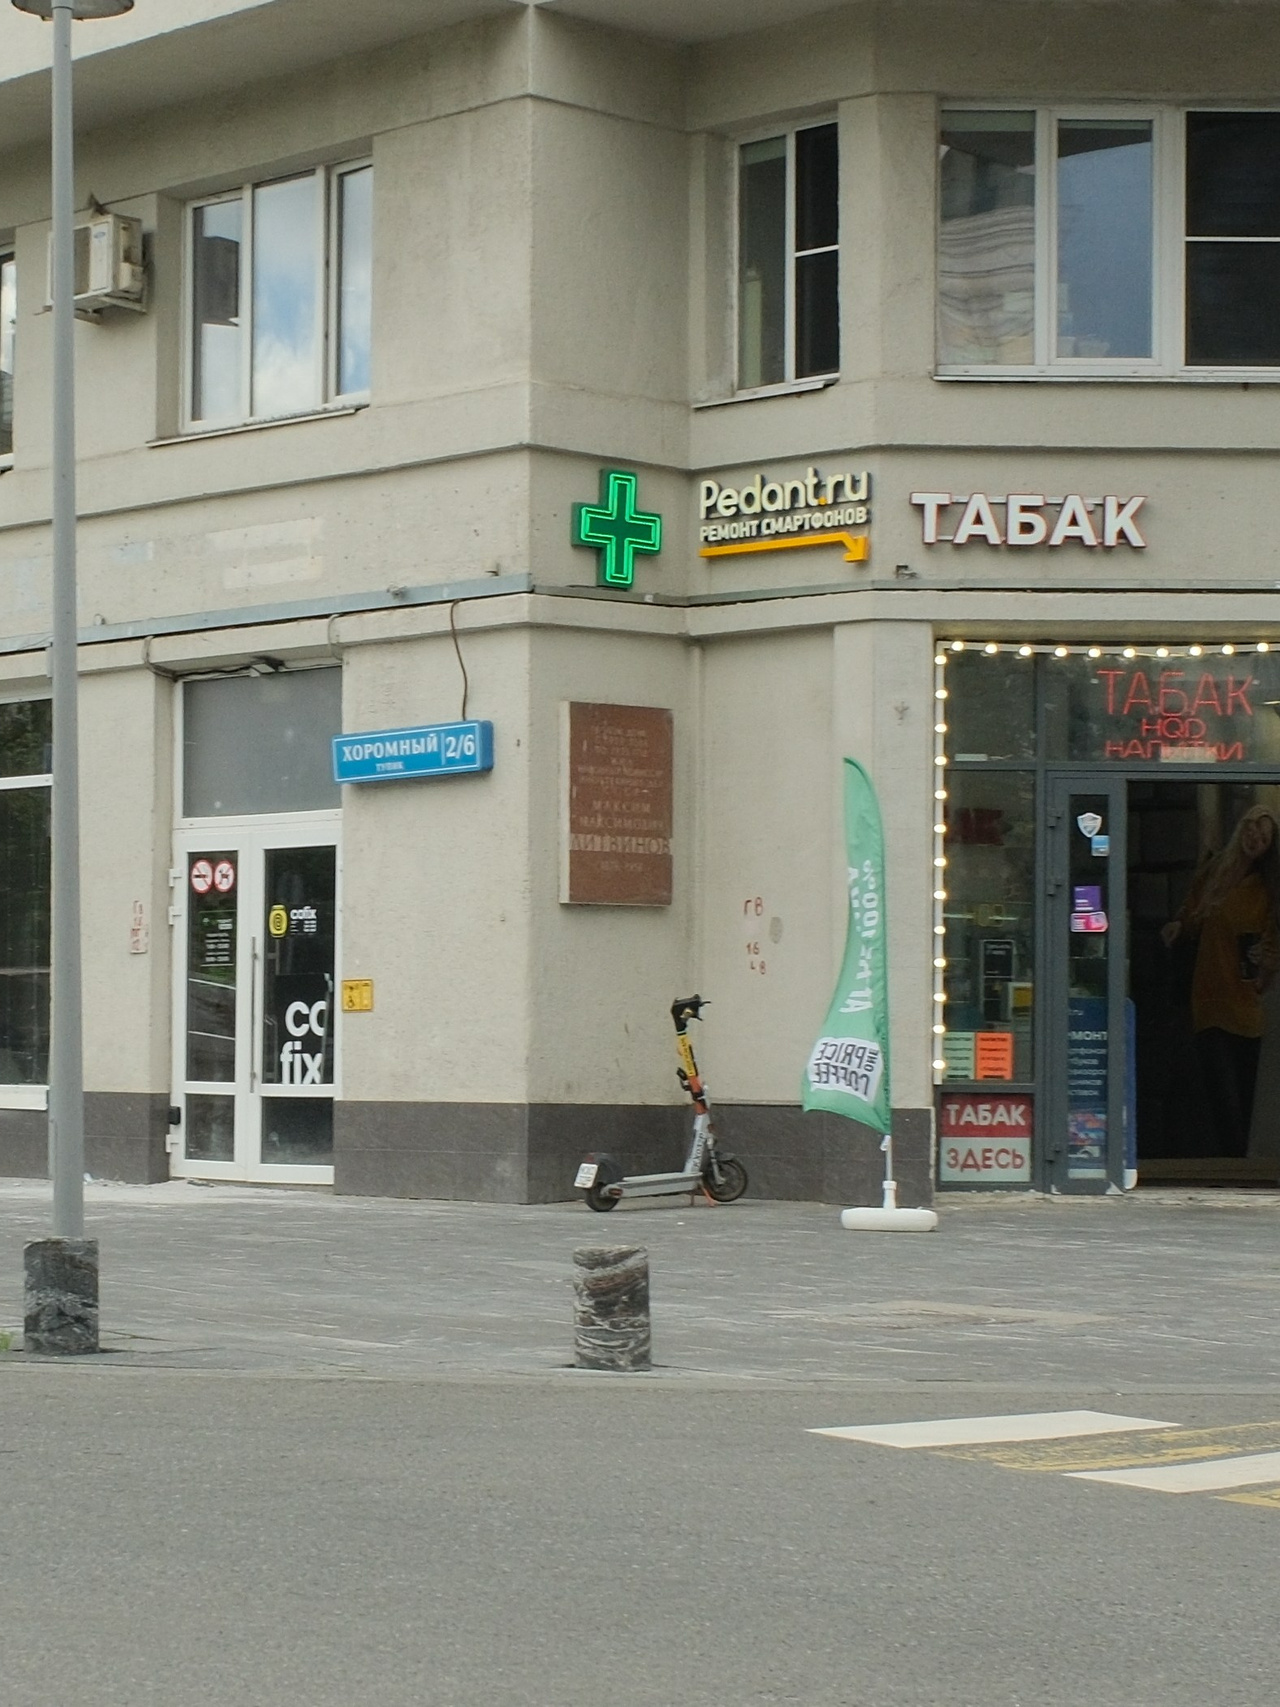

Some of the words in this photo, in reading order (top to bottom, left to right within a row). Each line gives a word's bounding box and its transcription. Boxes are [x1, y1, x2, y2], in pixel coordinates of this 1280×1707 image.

[700, 467, 869, 519] Pedant.ru
[700, 520, 760, 542] РЕМОНТ
[761, 507, 868, 535] СМАРТФОНОВ
[910, 491, 1147, 547] ТАБАК
[1097, 669, 1253, 717] ТАБАК
[1141, 717, 1207, 740] HQD
[342, 733, 438, 762] ХОРОМНЫЙ
[445, 734, 475, 759] 2/6
[280, 1041, 322, 1084] fix
[946, 1104, 1026, 1126] ТАБАК
[946, 1148, 1025, 1172] ЗДЕСЬ
